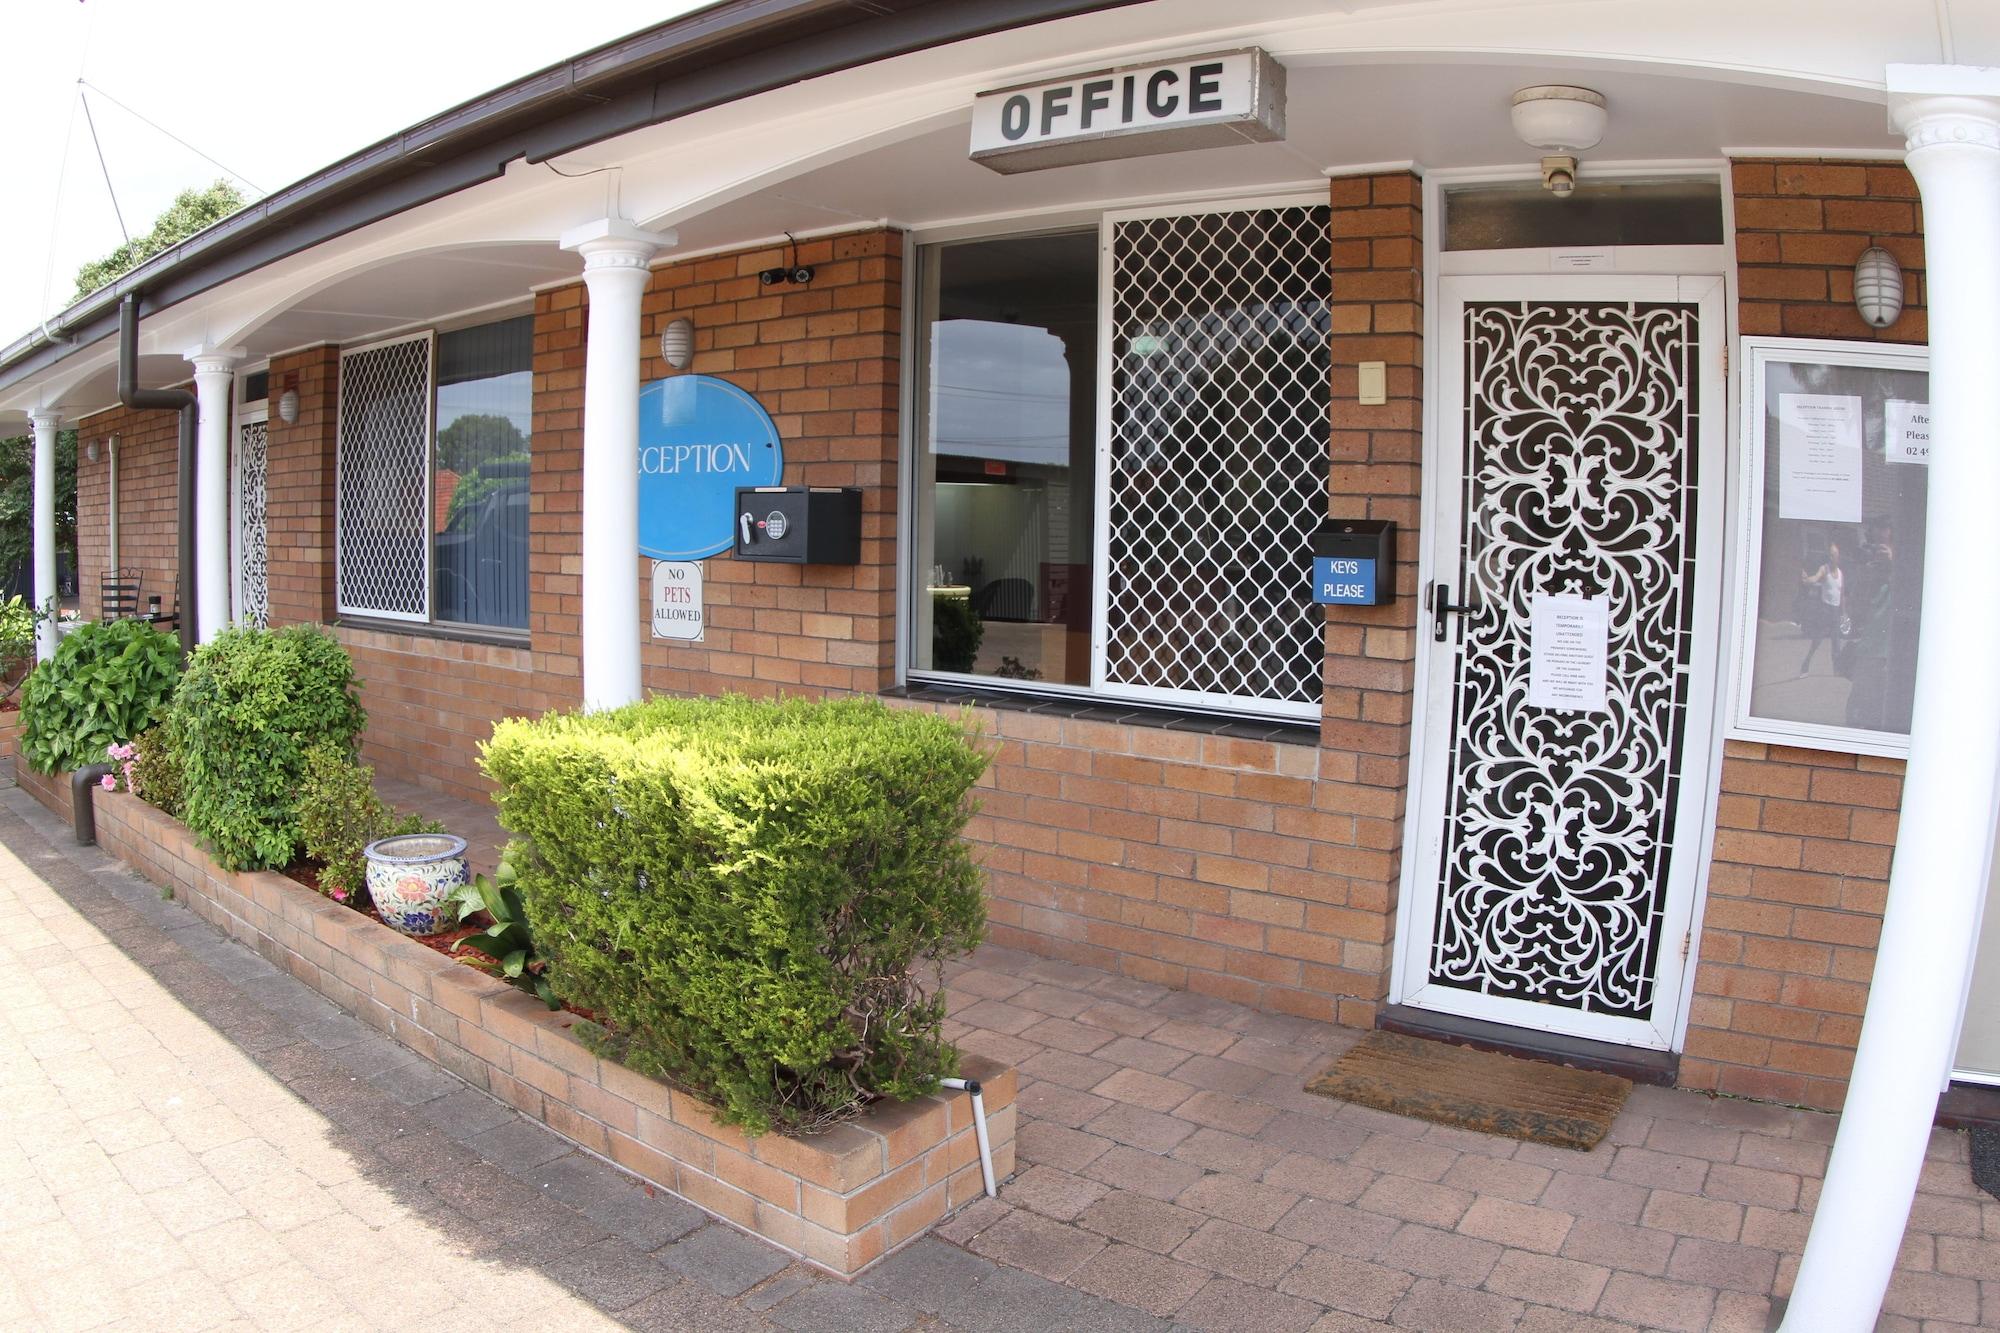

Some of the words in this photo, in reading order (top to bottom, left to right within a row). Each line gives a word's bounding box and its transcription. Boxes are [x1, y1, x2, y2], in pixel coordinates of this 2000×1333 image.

[1001, 62, 1223, 141] OFFICE
[1906, 446, 1918, 456] 02
[637, 443, 750, 474] CEPTION
[668, 568, 685, 581] NO
[1331, 561, 1358, 574] KEYS
[664, 586, 691, 603] PETS
[1323, 583, 1364, 597] PLEASE
[654, 608, 701, 622] ALLOWED
